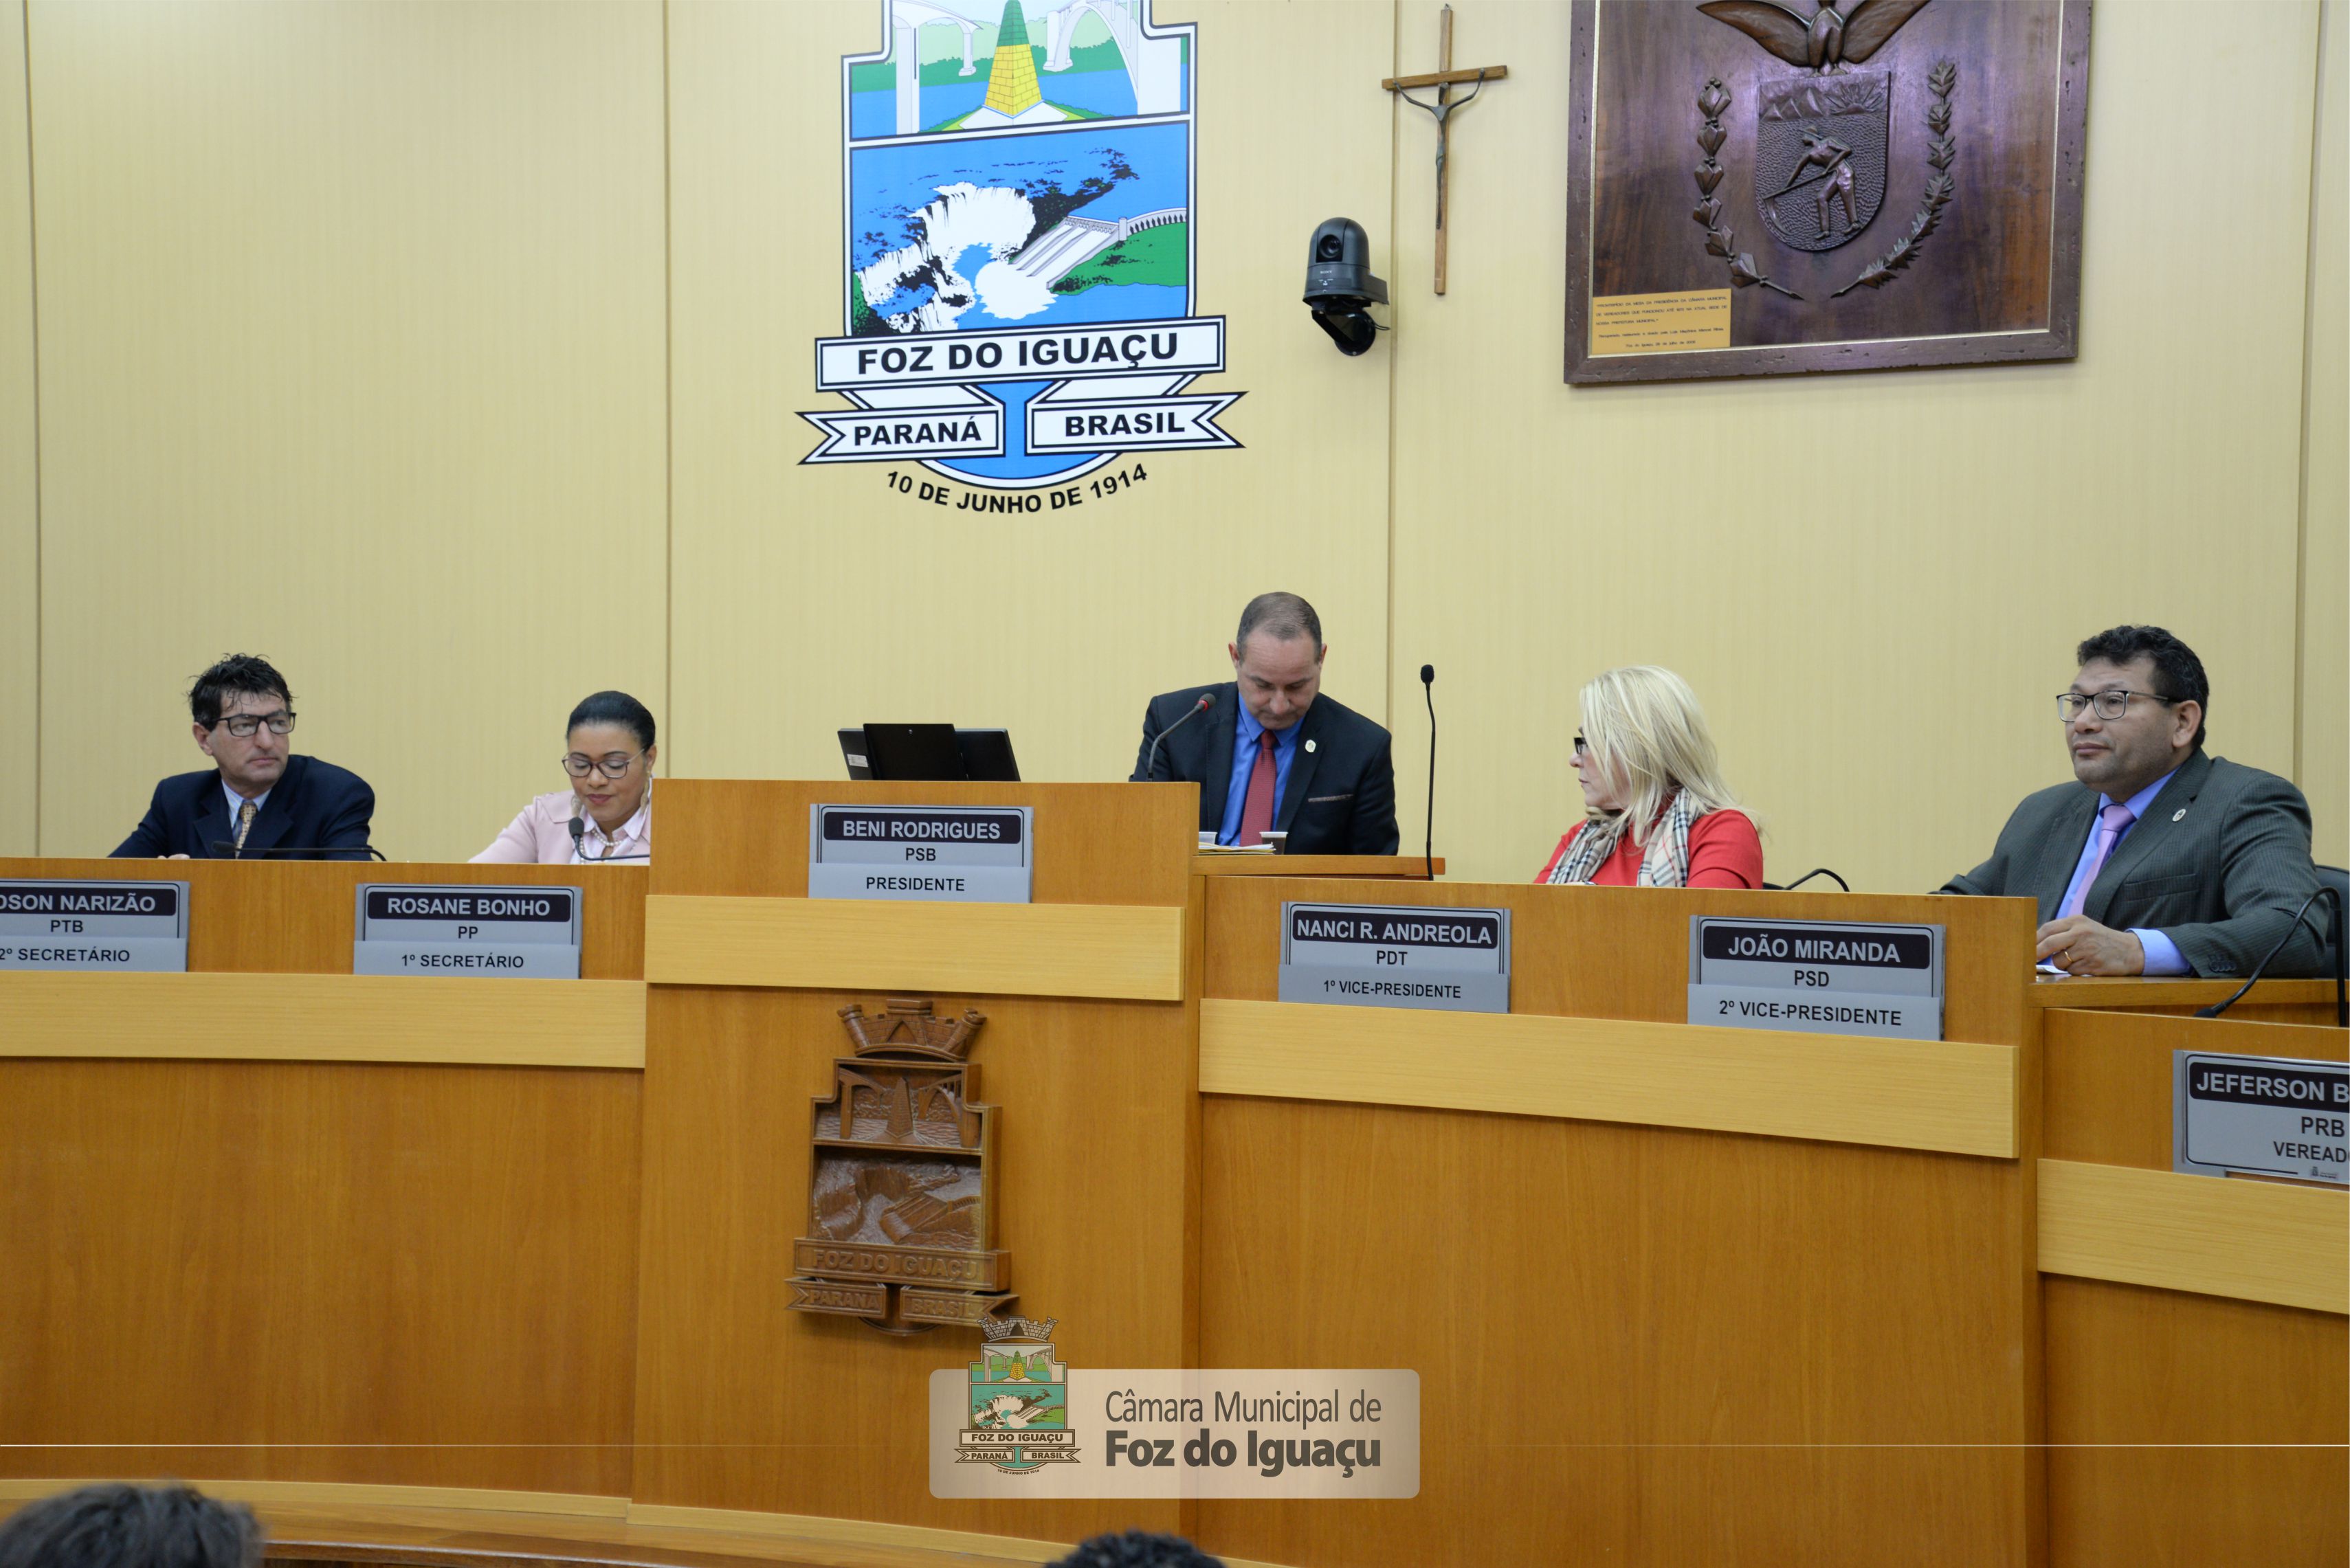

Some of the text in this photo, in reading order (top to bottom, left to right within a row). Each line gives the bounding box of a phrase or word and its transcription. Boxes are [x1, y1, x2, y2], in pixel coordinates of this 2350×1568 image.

[859, 333, 1178, 374] FOZ DO IGUAÇU
[854, 416, 982, 446] PARANÁ
[1066, 412, 1184, 436] BRASIL
[889, 462, 1147, 513] 10 DE JUNHO DE 1914
[843, 821, 1000, 839] BENI RODRIGUES
[906, 848, 935, 861] PSB
[867, 877, 964, 891] PRESIDENTE
[60, 893, 155, 911] NARIZÃO
[388, 898, 549, 915] ROSANE BONHO
[51, 920, 82, 932] PTB
[458, 926, 478, 939] PP
[1298, 919, 1492, 943] NANCI R. ANDREOLA
[18, 946, 130, 962] SECRETÁRIO
[1377, 950, 1407, 965] PDT
[1729, 934, 1900, 962] JOÃO MIRANDA
[402, 953, 523, 967] 1º SECRETÁRIO
[1795, 970, 1829, 987] PSD
[1324, 981, 1461, 998] 1º VICE-PRESIDENTE
[1720, 1000, 1900, 1025] 2º VICE-PRESIDENTE
[2196, 1072, 2324, 1101] JEFERSON
[2302, 1117, 2345, 1137] PRB
[2274, 1141, 2349, 1163] VEREAD
[812, 1248, 978, 1281] FOZ DO IGUAÇU
[911, 1298, 975, 1318] BRASIL
